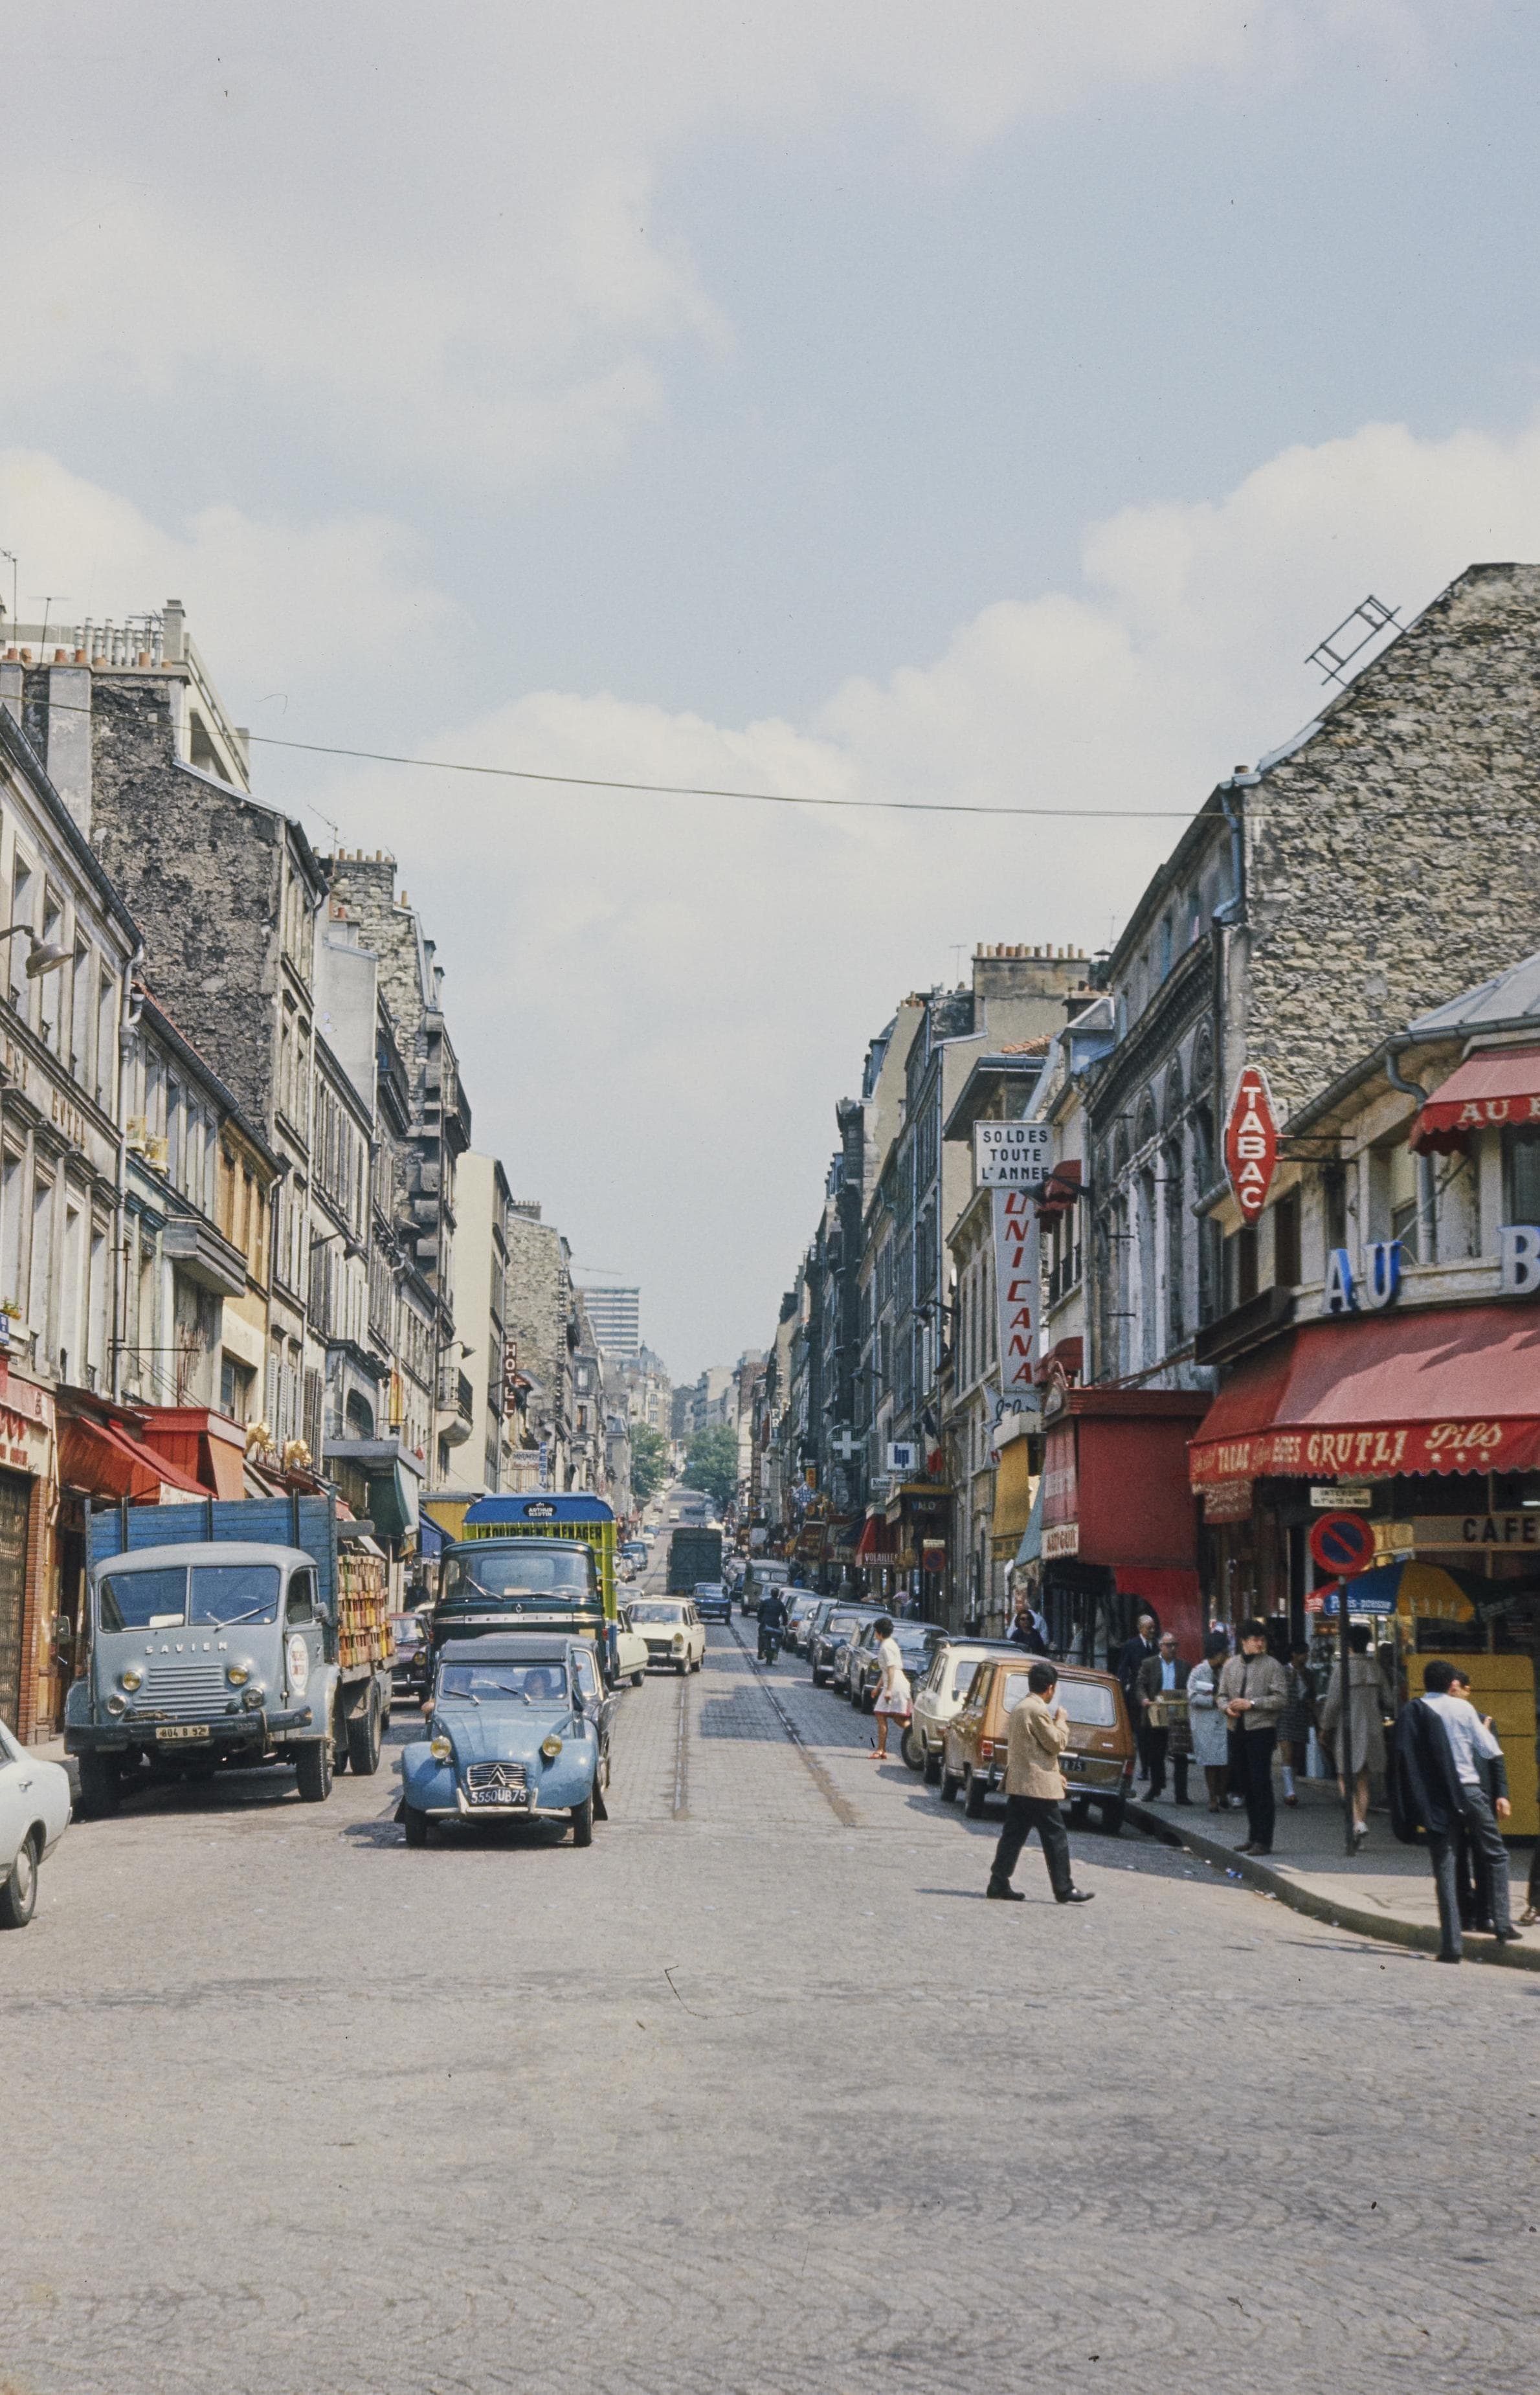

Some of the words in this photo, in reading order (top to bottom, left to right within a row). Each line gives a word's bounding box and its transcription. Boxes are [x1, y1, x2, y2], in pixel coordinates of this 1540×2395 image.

[1457, 1099, 1510, 1123] AU
[983, 1130, 1047, 1144] SOLDES
[1238, 1087, 1266, 1209] TABAC
[990, 1148, 1042, 1162] TOUTE
[1322, 1240, 1402, 1315] AU
[504, 1344, 516, 1414] HOTEL
[1425, 1423, 1502, 1450] Pils
[1462, 1517, 1537, 1543] CAFE
[145, 1641, 227, 1655] SAVIEM
[161, 1727, 179, 1737] 804
[192, 1726, 205, 1735] 92
